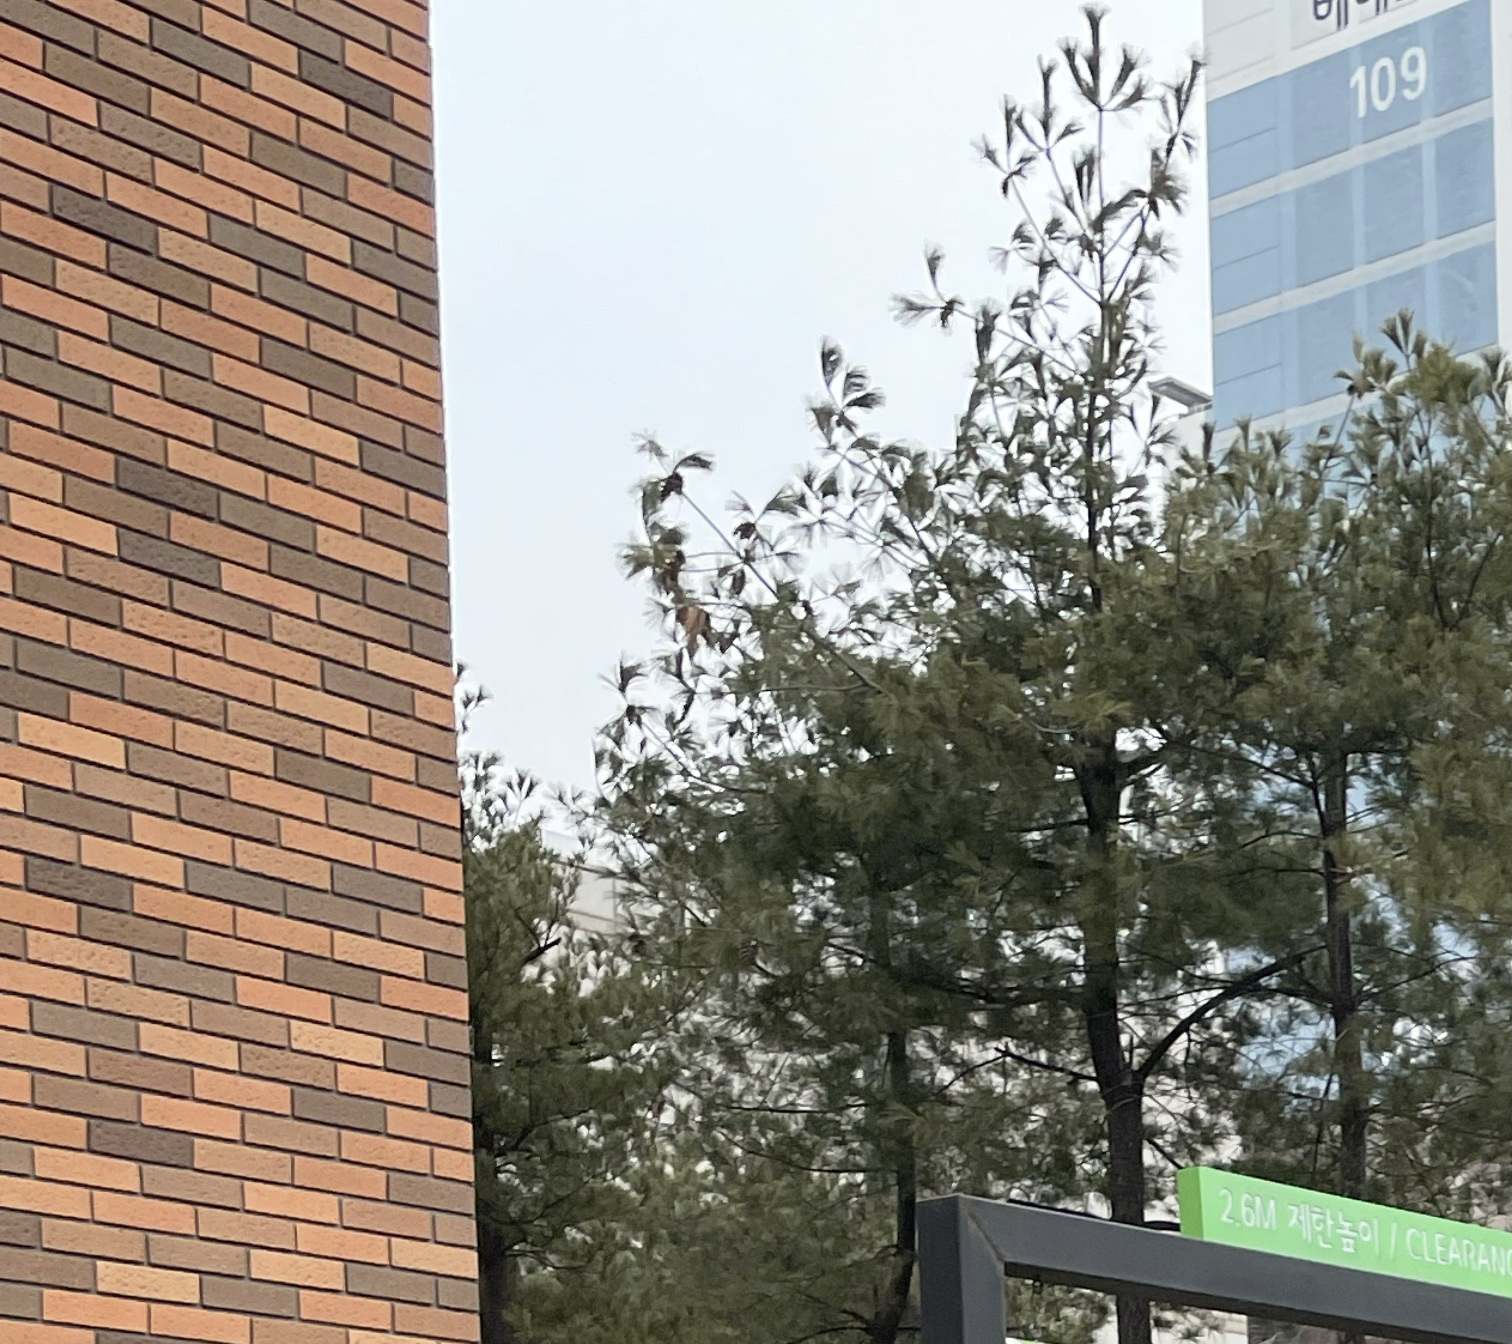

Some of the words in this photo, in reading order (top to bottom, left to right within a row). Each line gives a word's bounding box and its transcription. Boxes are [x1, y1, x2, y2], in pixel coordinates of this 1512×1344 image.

[1349, 46, 1428, 118] 109
[1219, 1188, 1277, 1231] 2.6M
[1287, 1202, 1379, 1257] 제한높이
